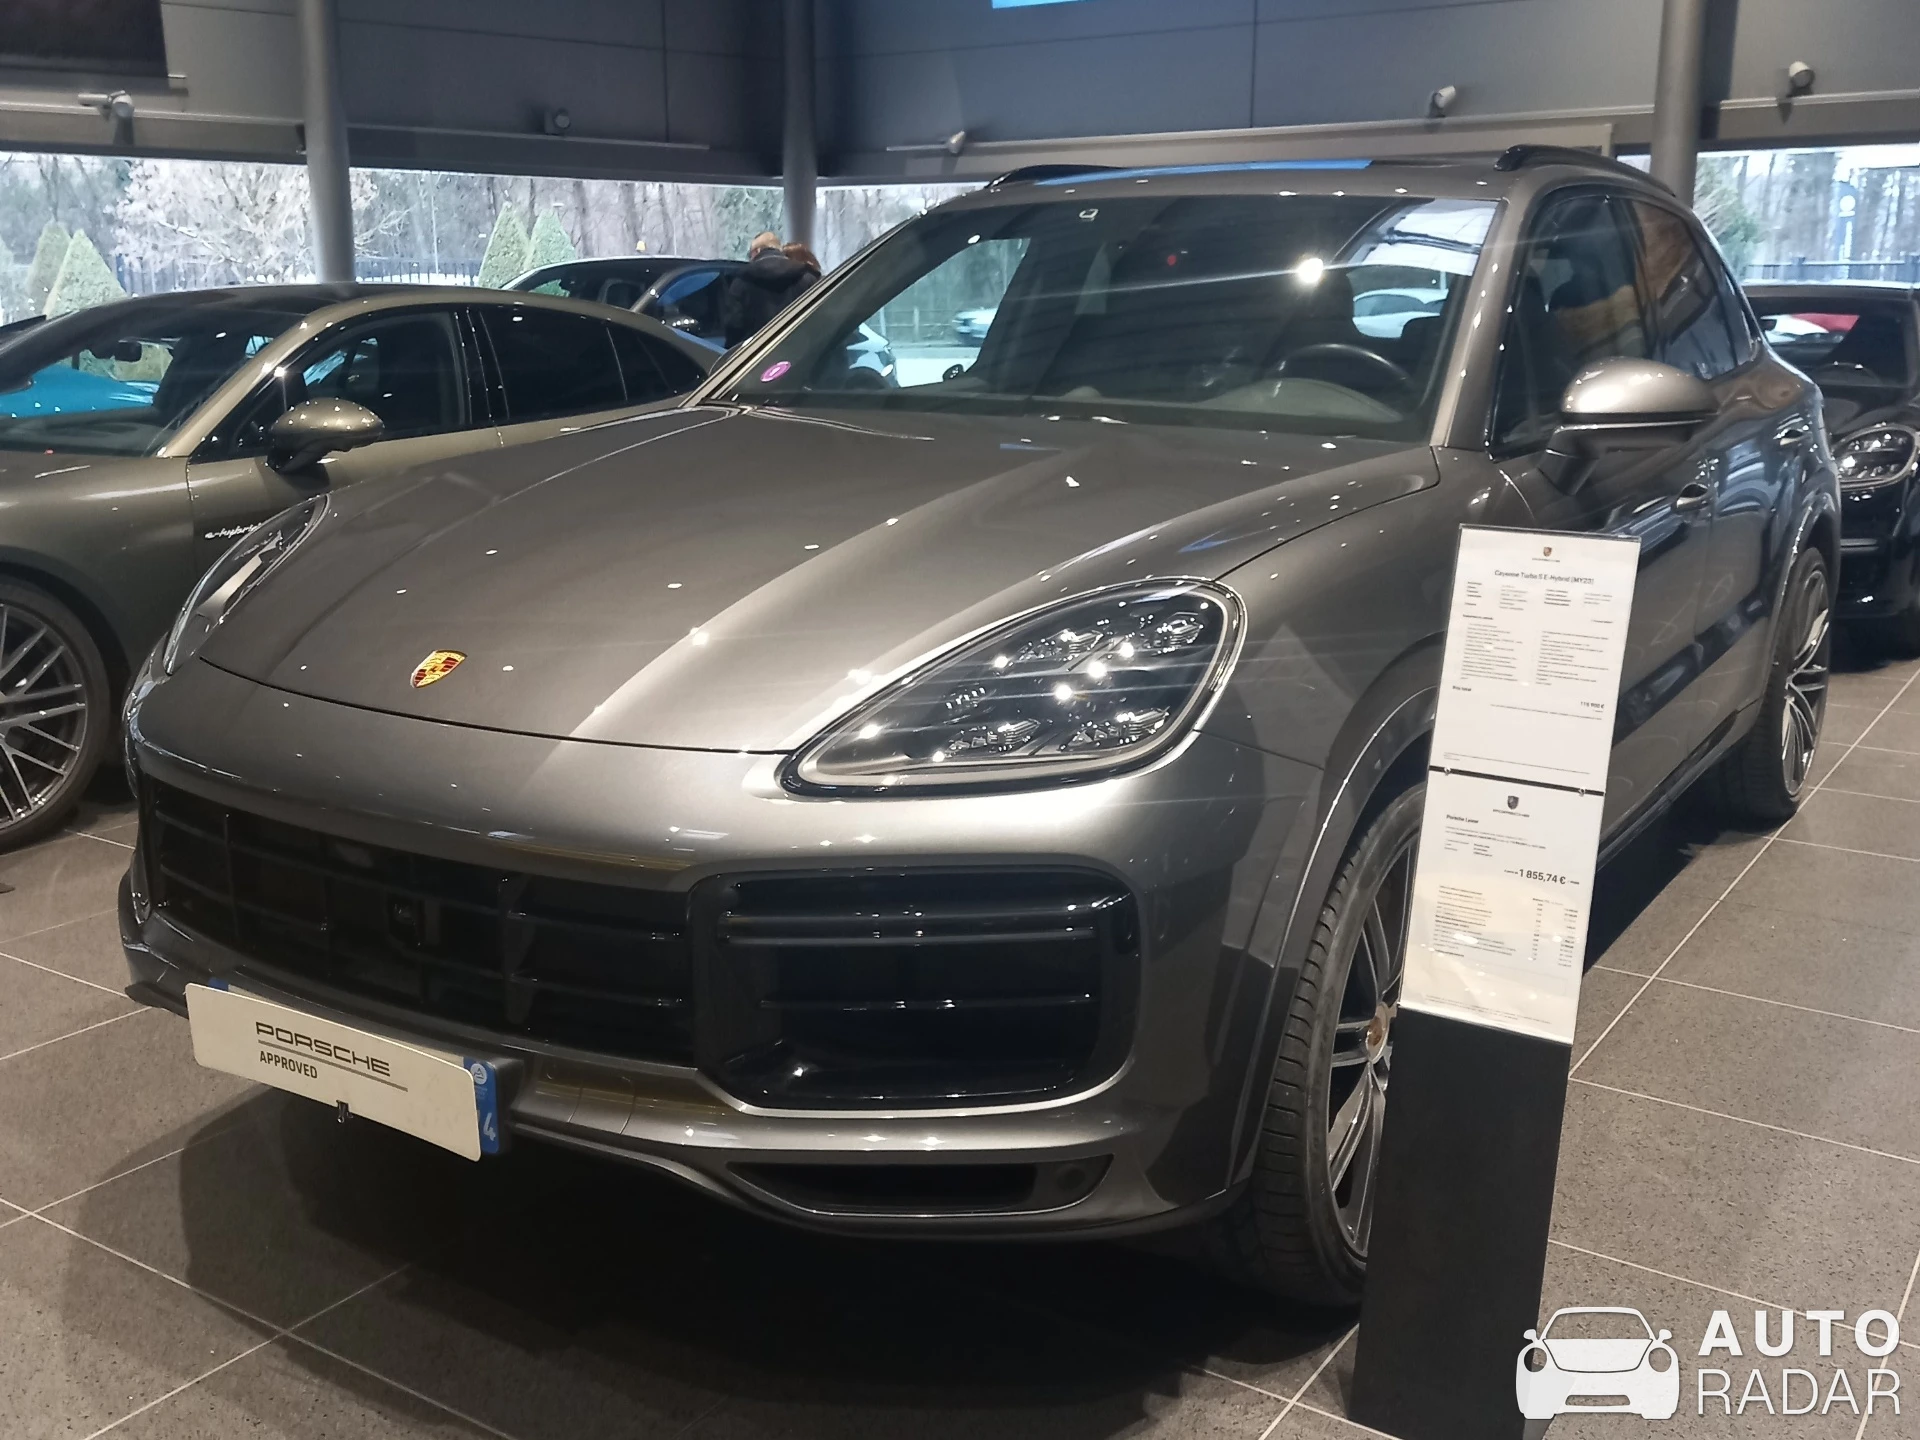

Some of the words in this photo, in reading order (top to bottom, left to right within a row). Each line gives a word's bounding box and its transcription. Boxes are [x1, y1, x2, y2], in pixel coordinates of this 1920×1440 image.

[1521, 572, 1538, 580] Turbo
[1519, 868, 1524, 877] 1
[1526, 870, 1558, 883] 855,74
[1559, 876, 1566, 885] €
[256, 1021, 391, 1077] PORSCHE
[260, 1051, 318, 1079] APPROVED
